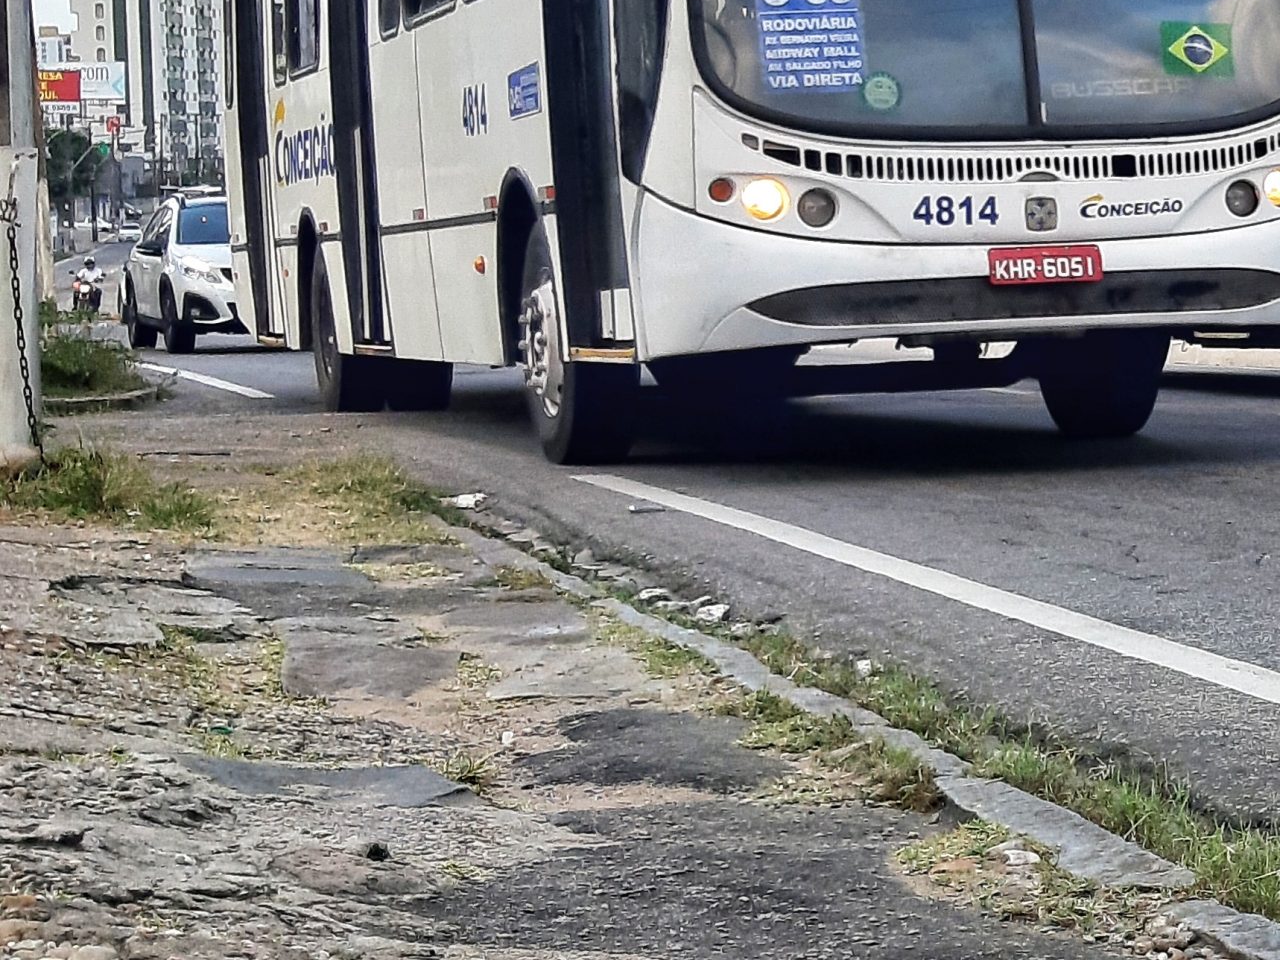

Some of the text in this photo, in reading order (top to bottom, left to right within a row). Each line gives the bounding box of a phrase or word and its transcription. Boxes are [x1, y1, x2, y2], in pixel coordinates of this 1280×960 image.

[763, 15, 857, 31] RODOVIÁRIA
[769, 72, 863, 88] VIA DIRETA
[463, 82, 488, 137] 4814
[912, 195, 999, 226] 4814
